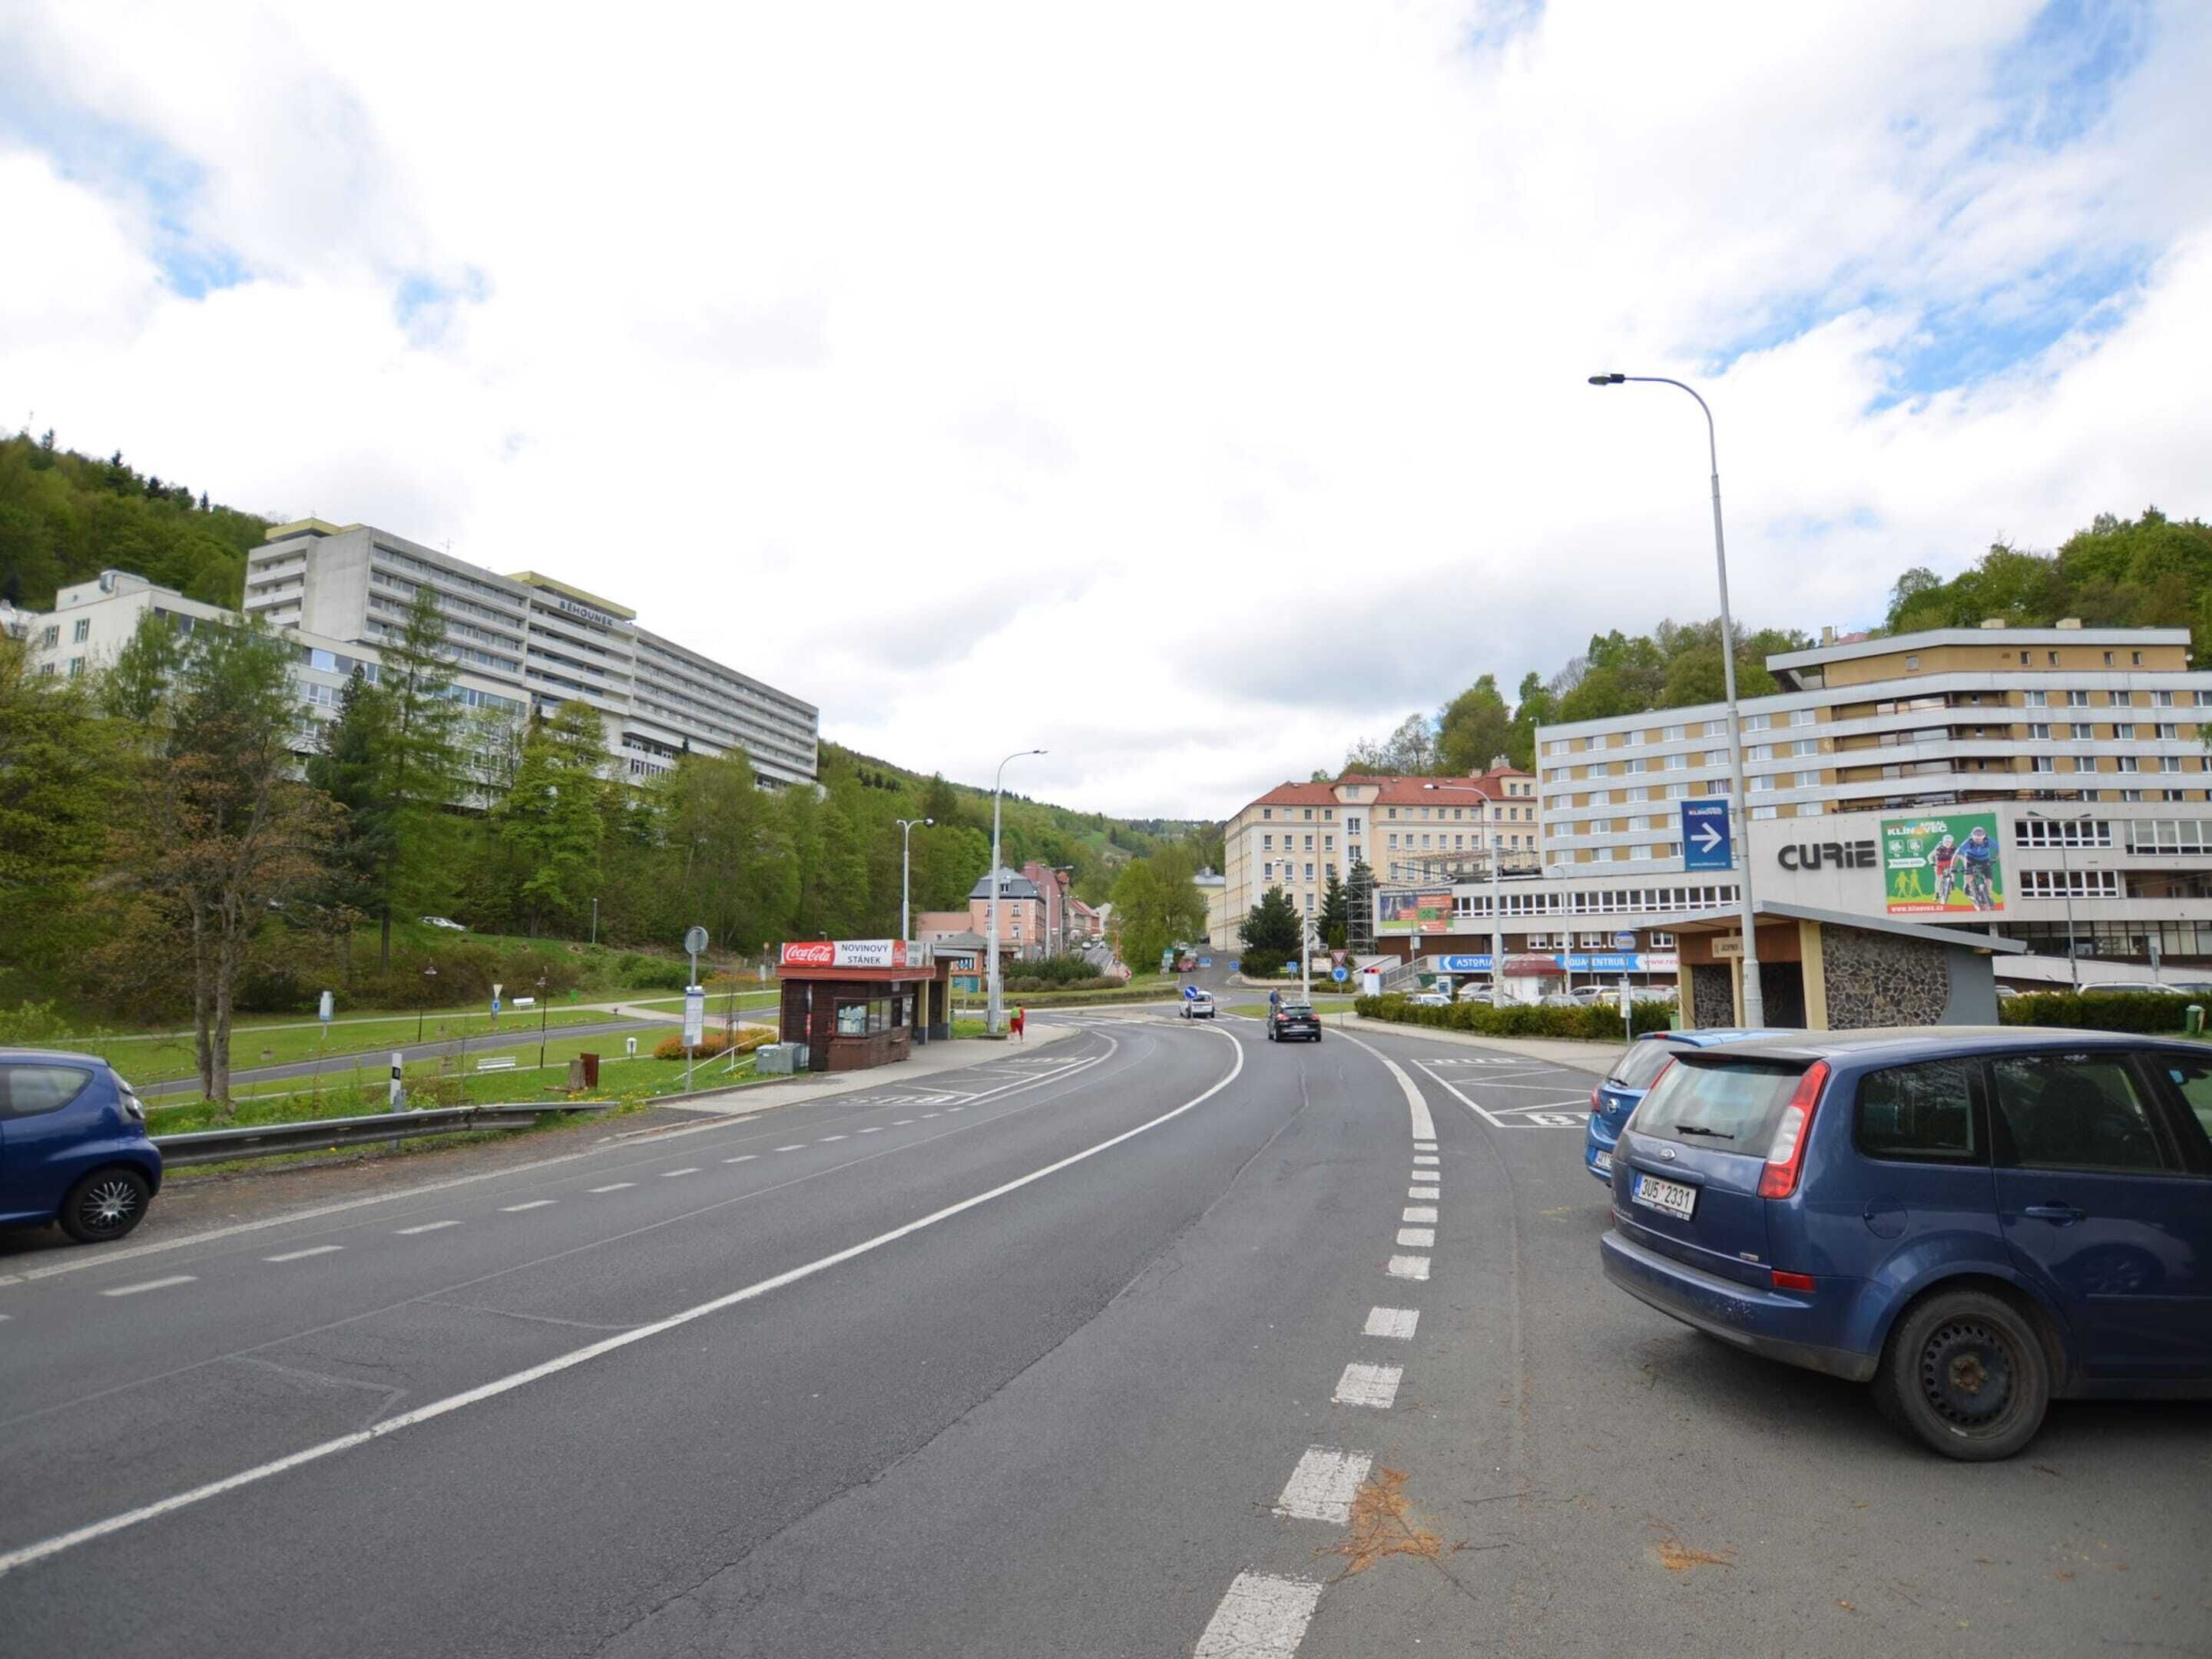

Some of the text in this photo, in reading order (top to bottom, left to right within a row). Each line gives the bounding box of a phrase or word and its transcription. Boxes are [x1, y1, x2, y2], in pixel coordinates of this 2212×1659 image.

[841, 943, 889, 953] NOVINOVÝ
[847, 955, 881, 965] STÁNEK
[1641, 1179, 1690, 1210] 3U5 2331
